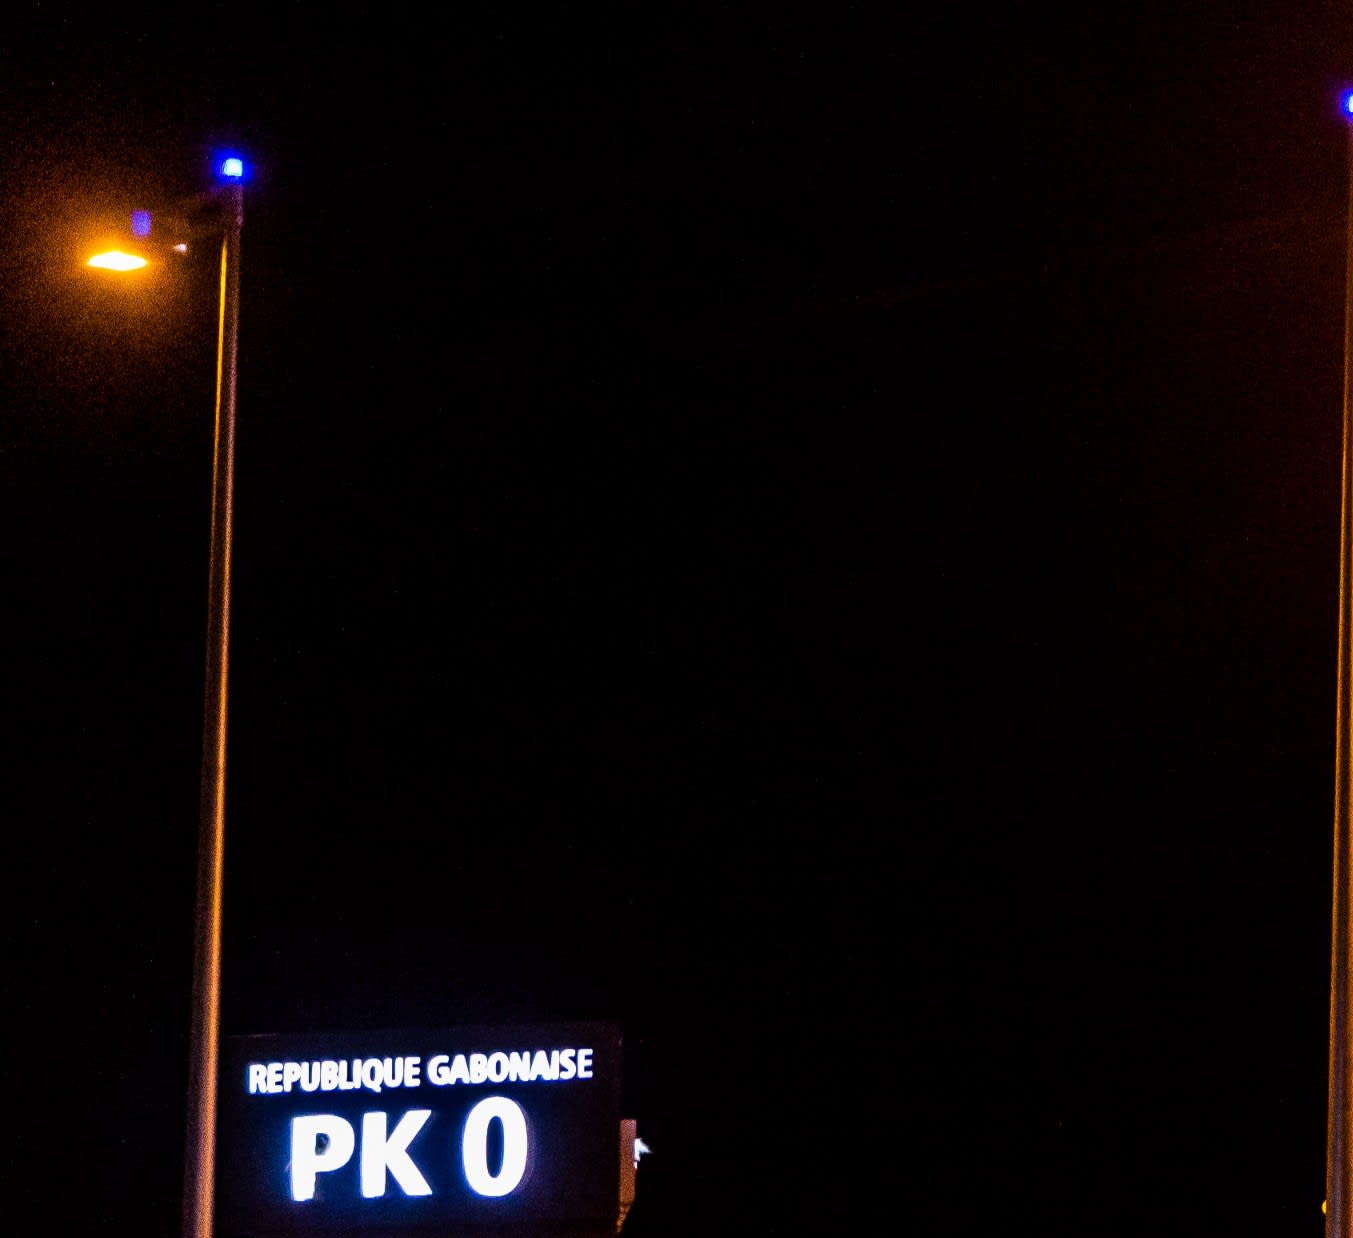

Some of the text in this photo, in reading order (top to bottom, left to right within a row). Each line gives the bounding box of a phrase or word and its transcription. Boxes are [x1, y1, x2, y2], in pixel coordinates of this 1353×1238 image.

[249, 1049, 594, 1093] REPUBLIQUE GABONAISE
[291, 1096, 528, 1201] PK 0
